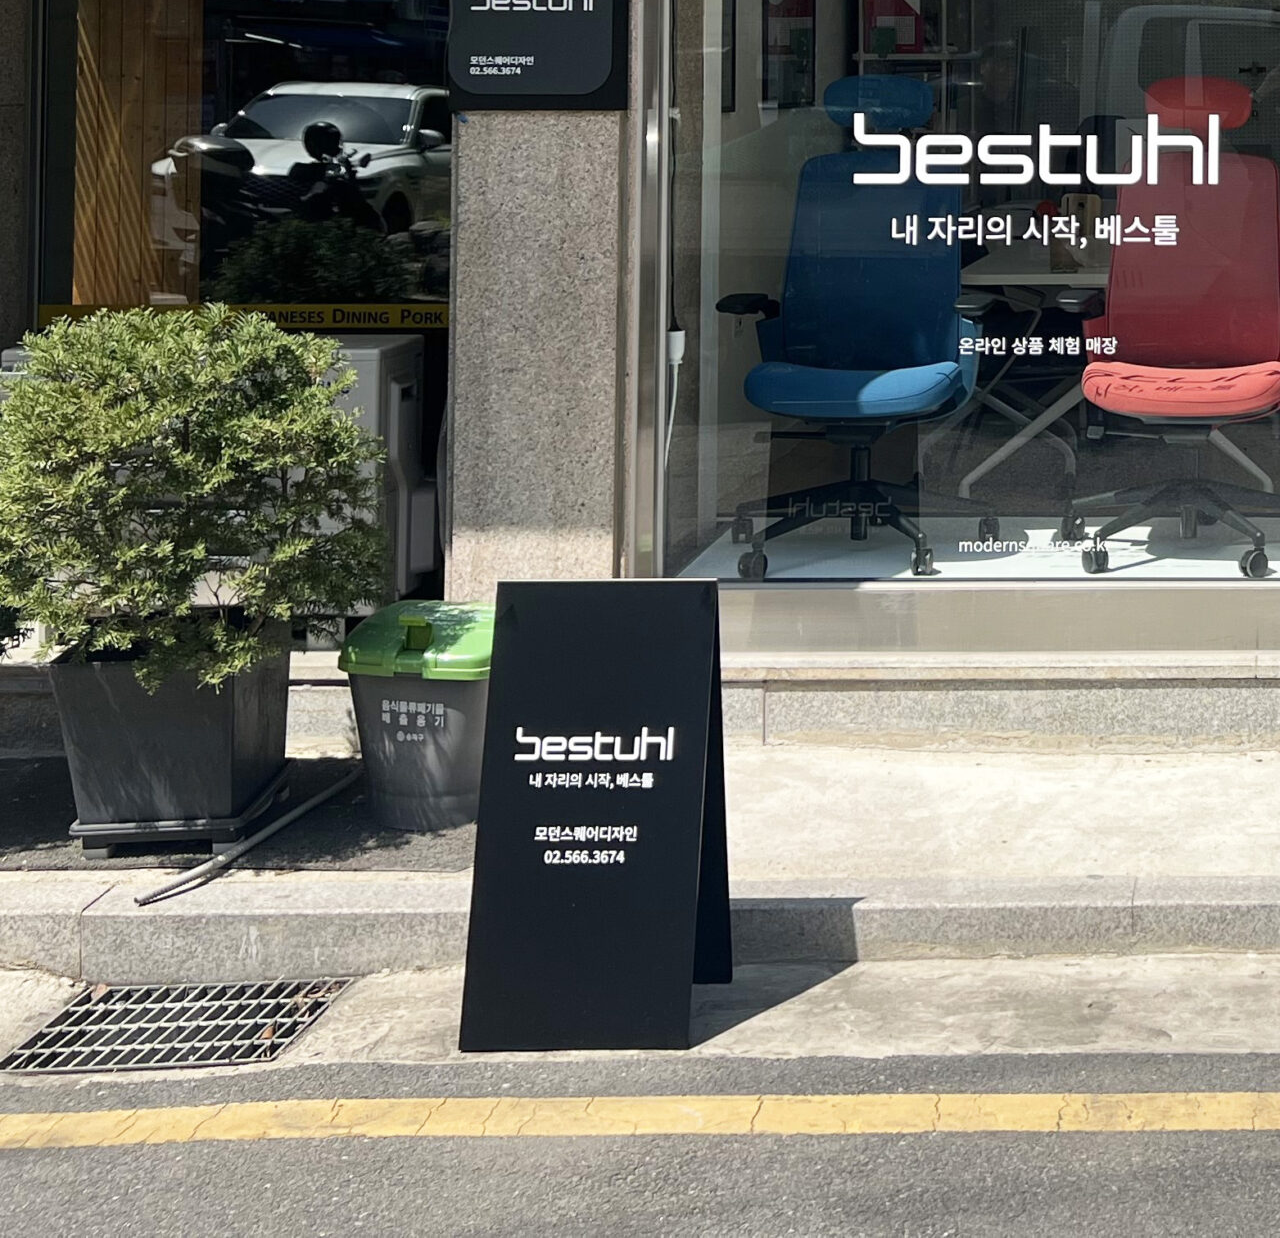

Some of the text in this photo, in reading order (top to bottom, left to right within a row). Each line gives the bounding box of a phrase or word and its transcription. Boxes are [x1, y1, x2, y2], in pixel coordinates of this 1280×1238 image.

[470, 55, 535, 66] 모던스퀘어디자인
[469, 66, 522, 75] 02.566.3674
[853, 112, 1220, 185] bestuhl
[891, 214, 1180, 249] 내 자리의 시작, 베스툴
[332, 308, 390, 324] DINING
[401, 309, 444, 324] PORK
[958, 337, 1118, 355] 온라인 상품 체험 매장
[514, 726, 675, 761] bestuhl
[529, 772, 655, 789] 내 자리의 시작, 베스툴
[534, 825, 638, 842] 모던스퀘어디자인
[543, 849, 625, 864] 02.566.3674
